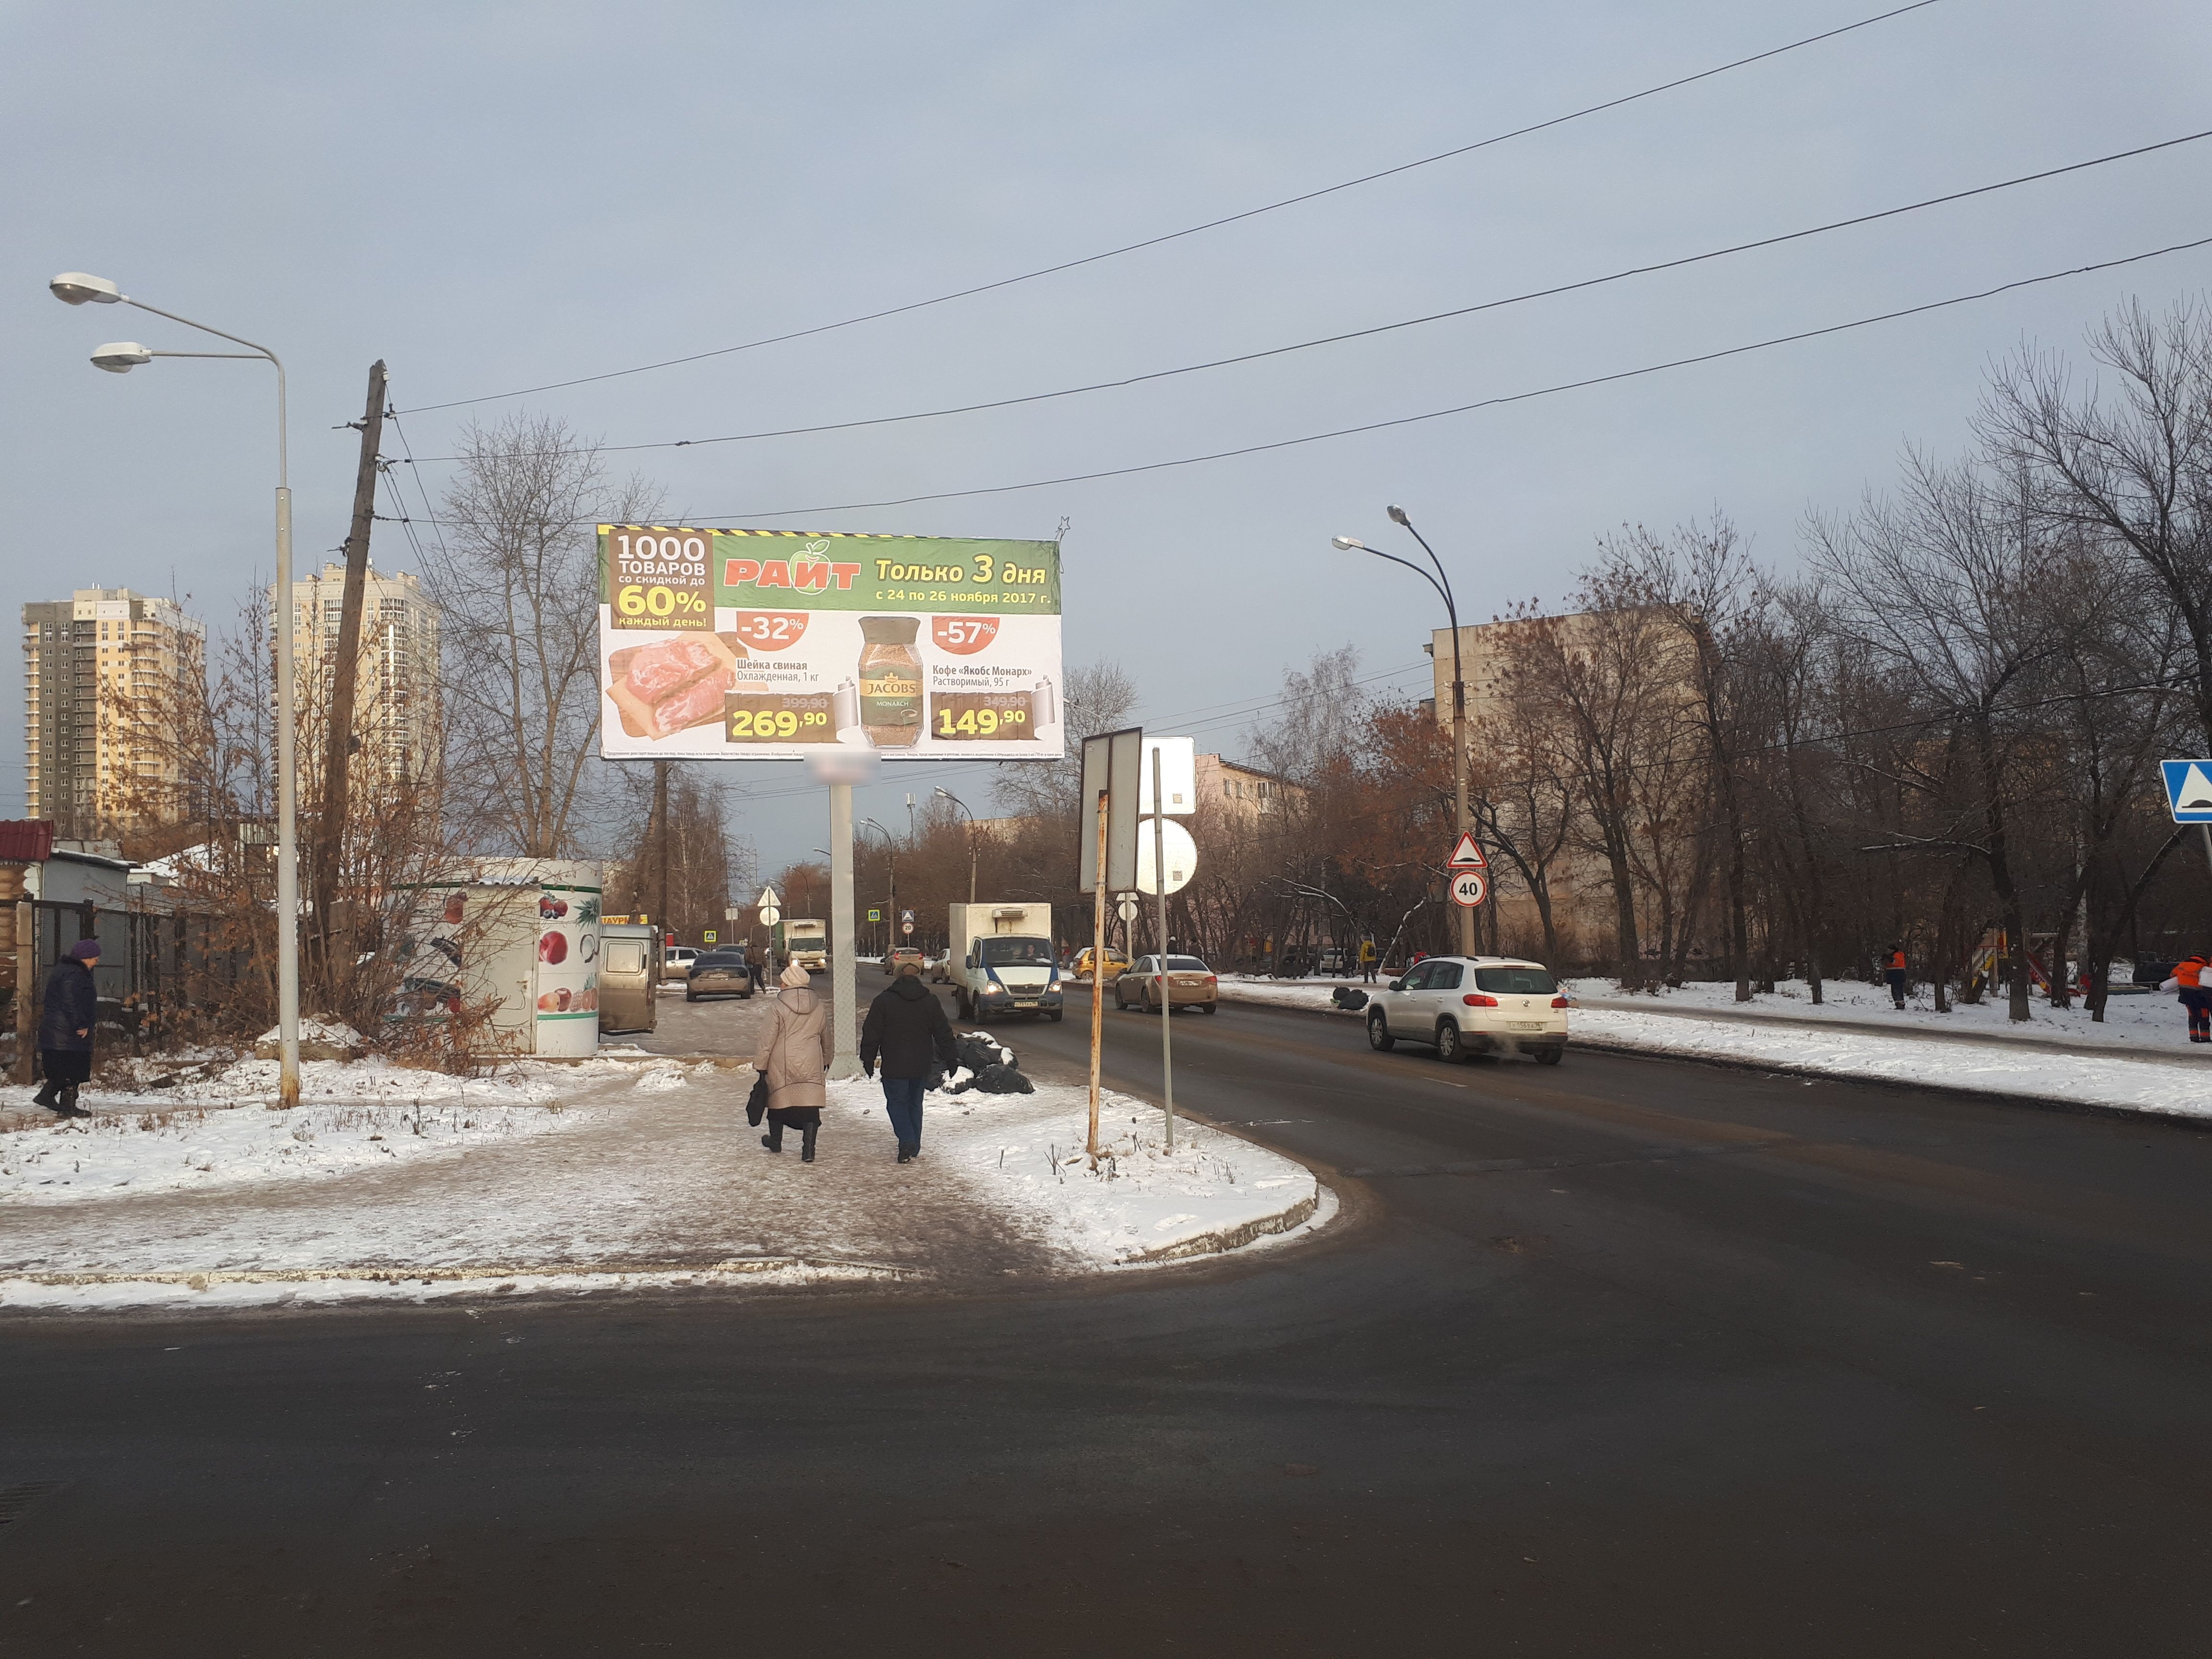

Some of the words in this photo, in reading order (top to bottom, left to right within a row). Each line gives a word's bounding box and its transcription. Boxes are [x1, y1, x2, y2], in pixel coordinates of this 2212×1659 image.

[618, 535, 705, 561] 1000
[619, 560, 705, 576] ТОВАРОВ
[723, 555, 861, 590] РАЙТ
[876, 559, 963, 582] Только
[972, 554, 994, 583] 3
[1002, 562, 1046, 584] дня
[636, 575, 686, 585] скидкой
[690, 577, 705, 586] до
[618, 585, 706, 616] 60%
[876, 590, 883, 600] с
[888, 589, 905, 600] 24
[909, 591, 925, 601] по
[930, 590, 946, 601] 26
[951, 591, 998, 604] ноября
[1002, 592, 1036, 603] 2017
[1040, 595, 1051, 603] г.
[619, 616, 669, 626] каждый
[673, 617, 707, 627] день!
[741, 616, 804, 640] -32%
[937, 622, 996, 644] -57%
[737, 659, 770, 669] Шейка
[773, 662, 807, 670] свиная
[933, 665, 956, 676] Кофе
[959, 665, 990, 675] «Якобс
[992, 666, 1032, 678] Монарх»
[737, 671, 801, 683] Охлажденная,
[804, 672, 807, 681] 1
[933, 676, 992, 688] Растворимый,
[994, 677, 1003, 686] 95
[867, 683, 916, 695] JACOBS
[1459, 882, 1478, 896] 40
